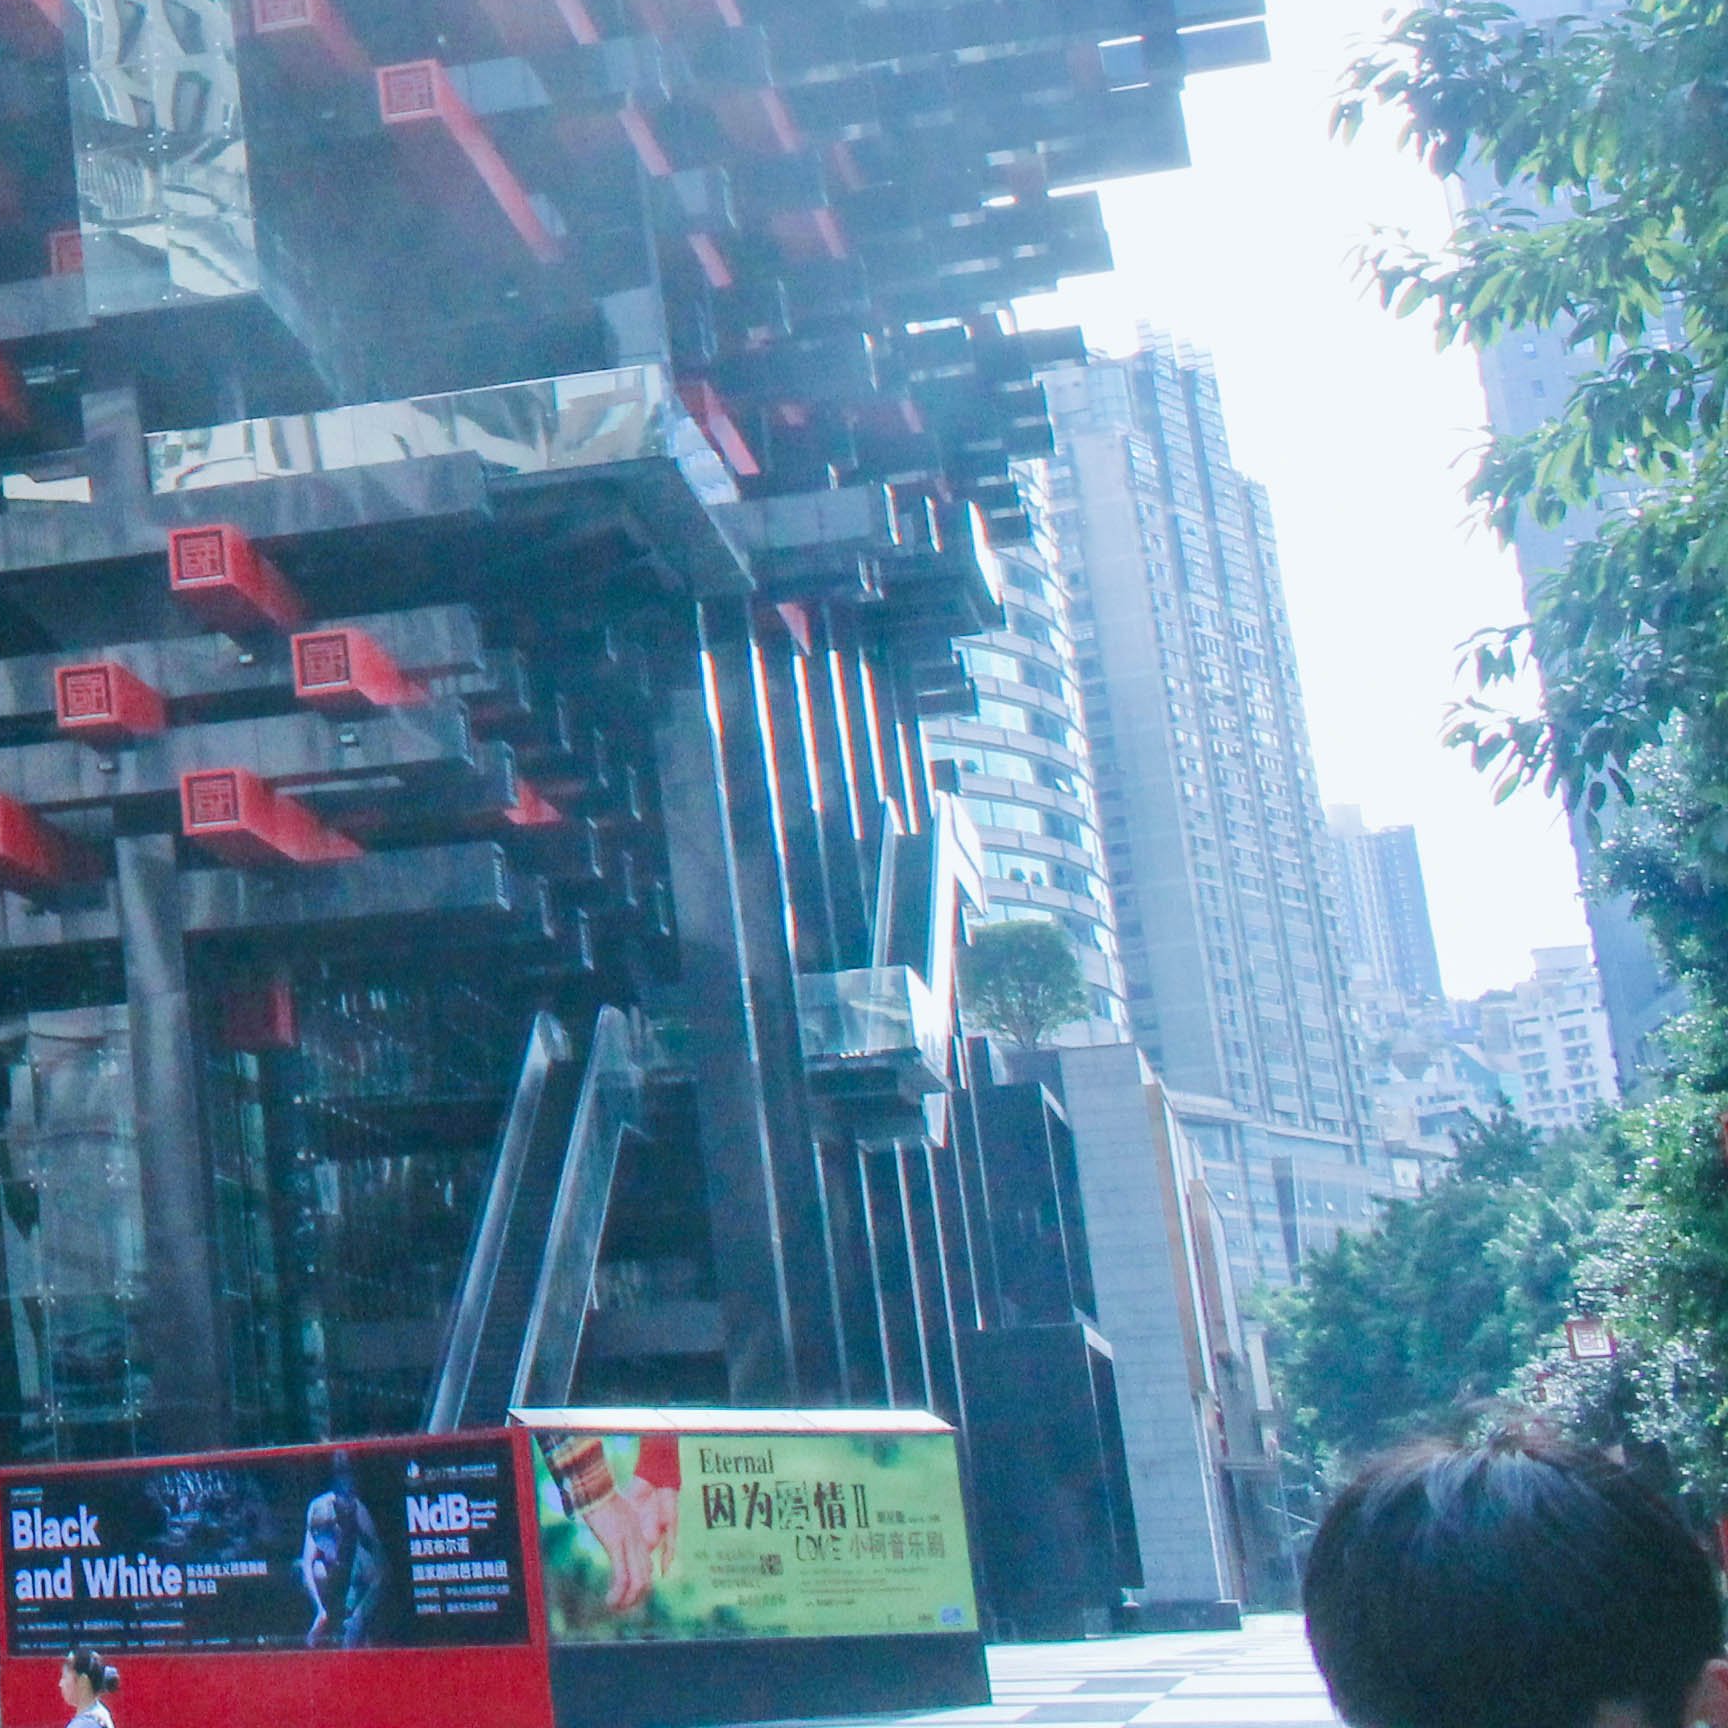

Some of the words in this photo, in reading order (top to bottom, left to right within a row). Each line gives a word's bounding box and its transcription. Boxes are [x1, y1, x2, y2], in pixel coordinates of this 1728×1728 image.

[699, 1448, 774, 1474] Eternal
[11, 1504, 101, 1549] Black
[406, 1493, 470, 1533] NdB
[15, 1556, 73, 1600] and
[81, 1552, 184, 1598] White
